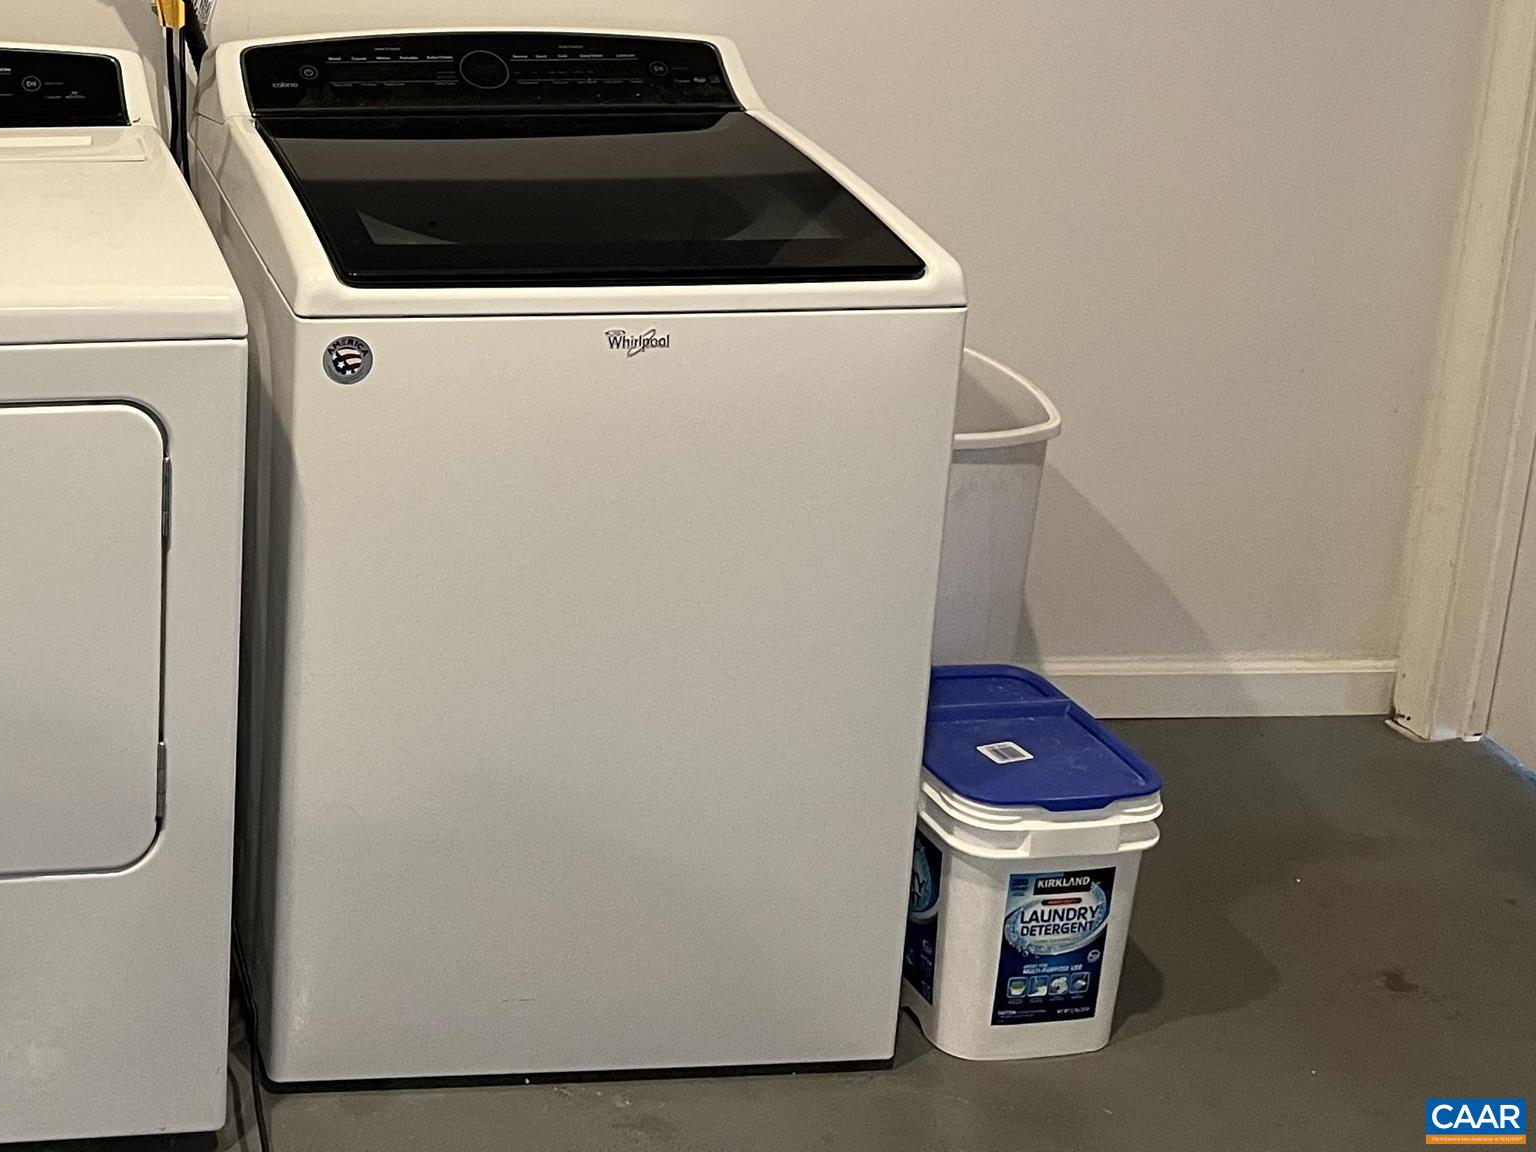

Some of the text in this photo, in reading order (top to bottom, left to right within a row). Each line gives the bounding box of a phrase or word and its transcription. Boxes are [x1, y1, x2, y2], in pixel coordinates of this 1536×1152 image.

[327, 338, 369, 357] AMERICA
[607, 333, 670, 353] Whirlpool
[1037, 876, 1090, 888] KIRKLAND
[1020, 905, 1100, 924] LAUNDRY
[1020, 921, 1095, 937] DETERGENT
